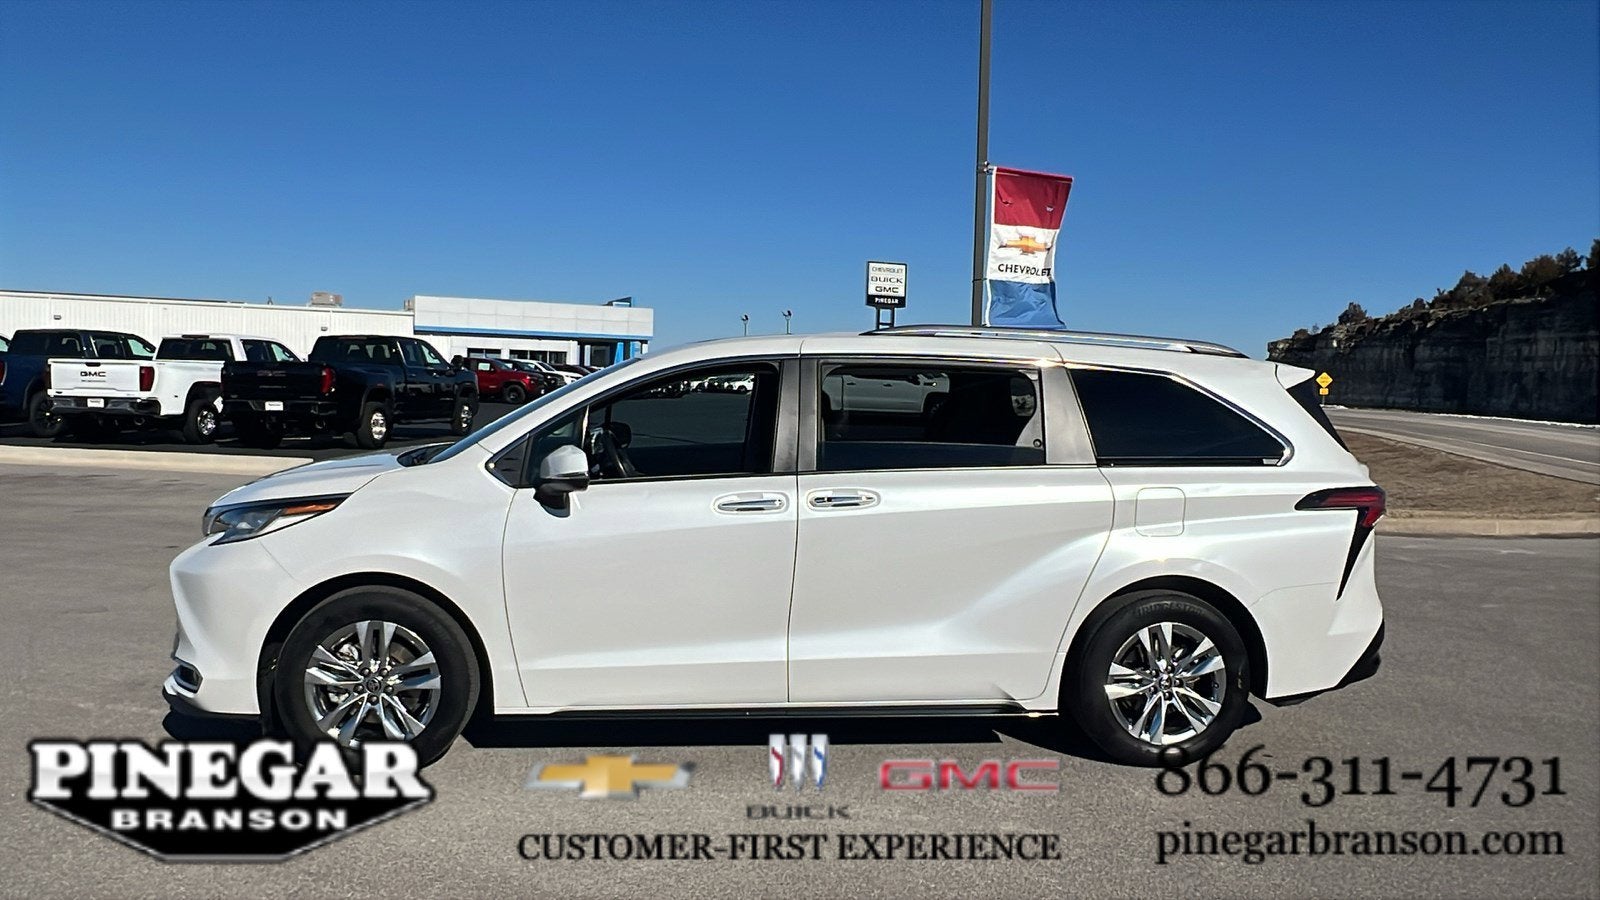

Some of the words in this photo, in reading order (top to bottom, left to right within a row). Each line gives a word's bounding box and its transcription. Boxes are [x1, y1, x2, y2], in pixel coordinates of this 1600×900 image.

[997, 263, 1052, 277] CHEVROLET
[870, 275, 903, 284] BUICK
[875, 285, 899, 294] GMC
